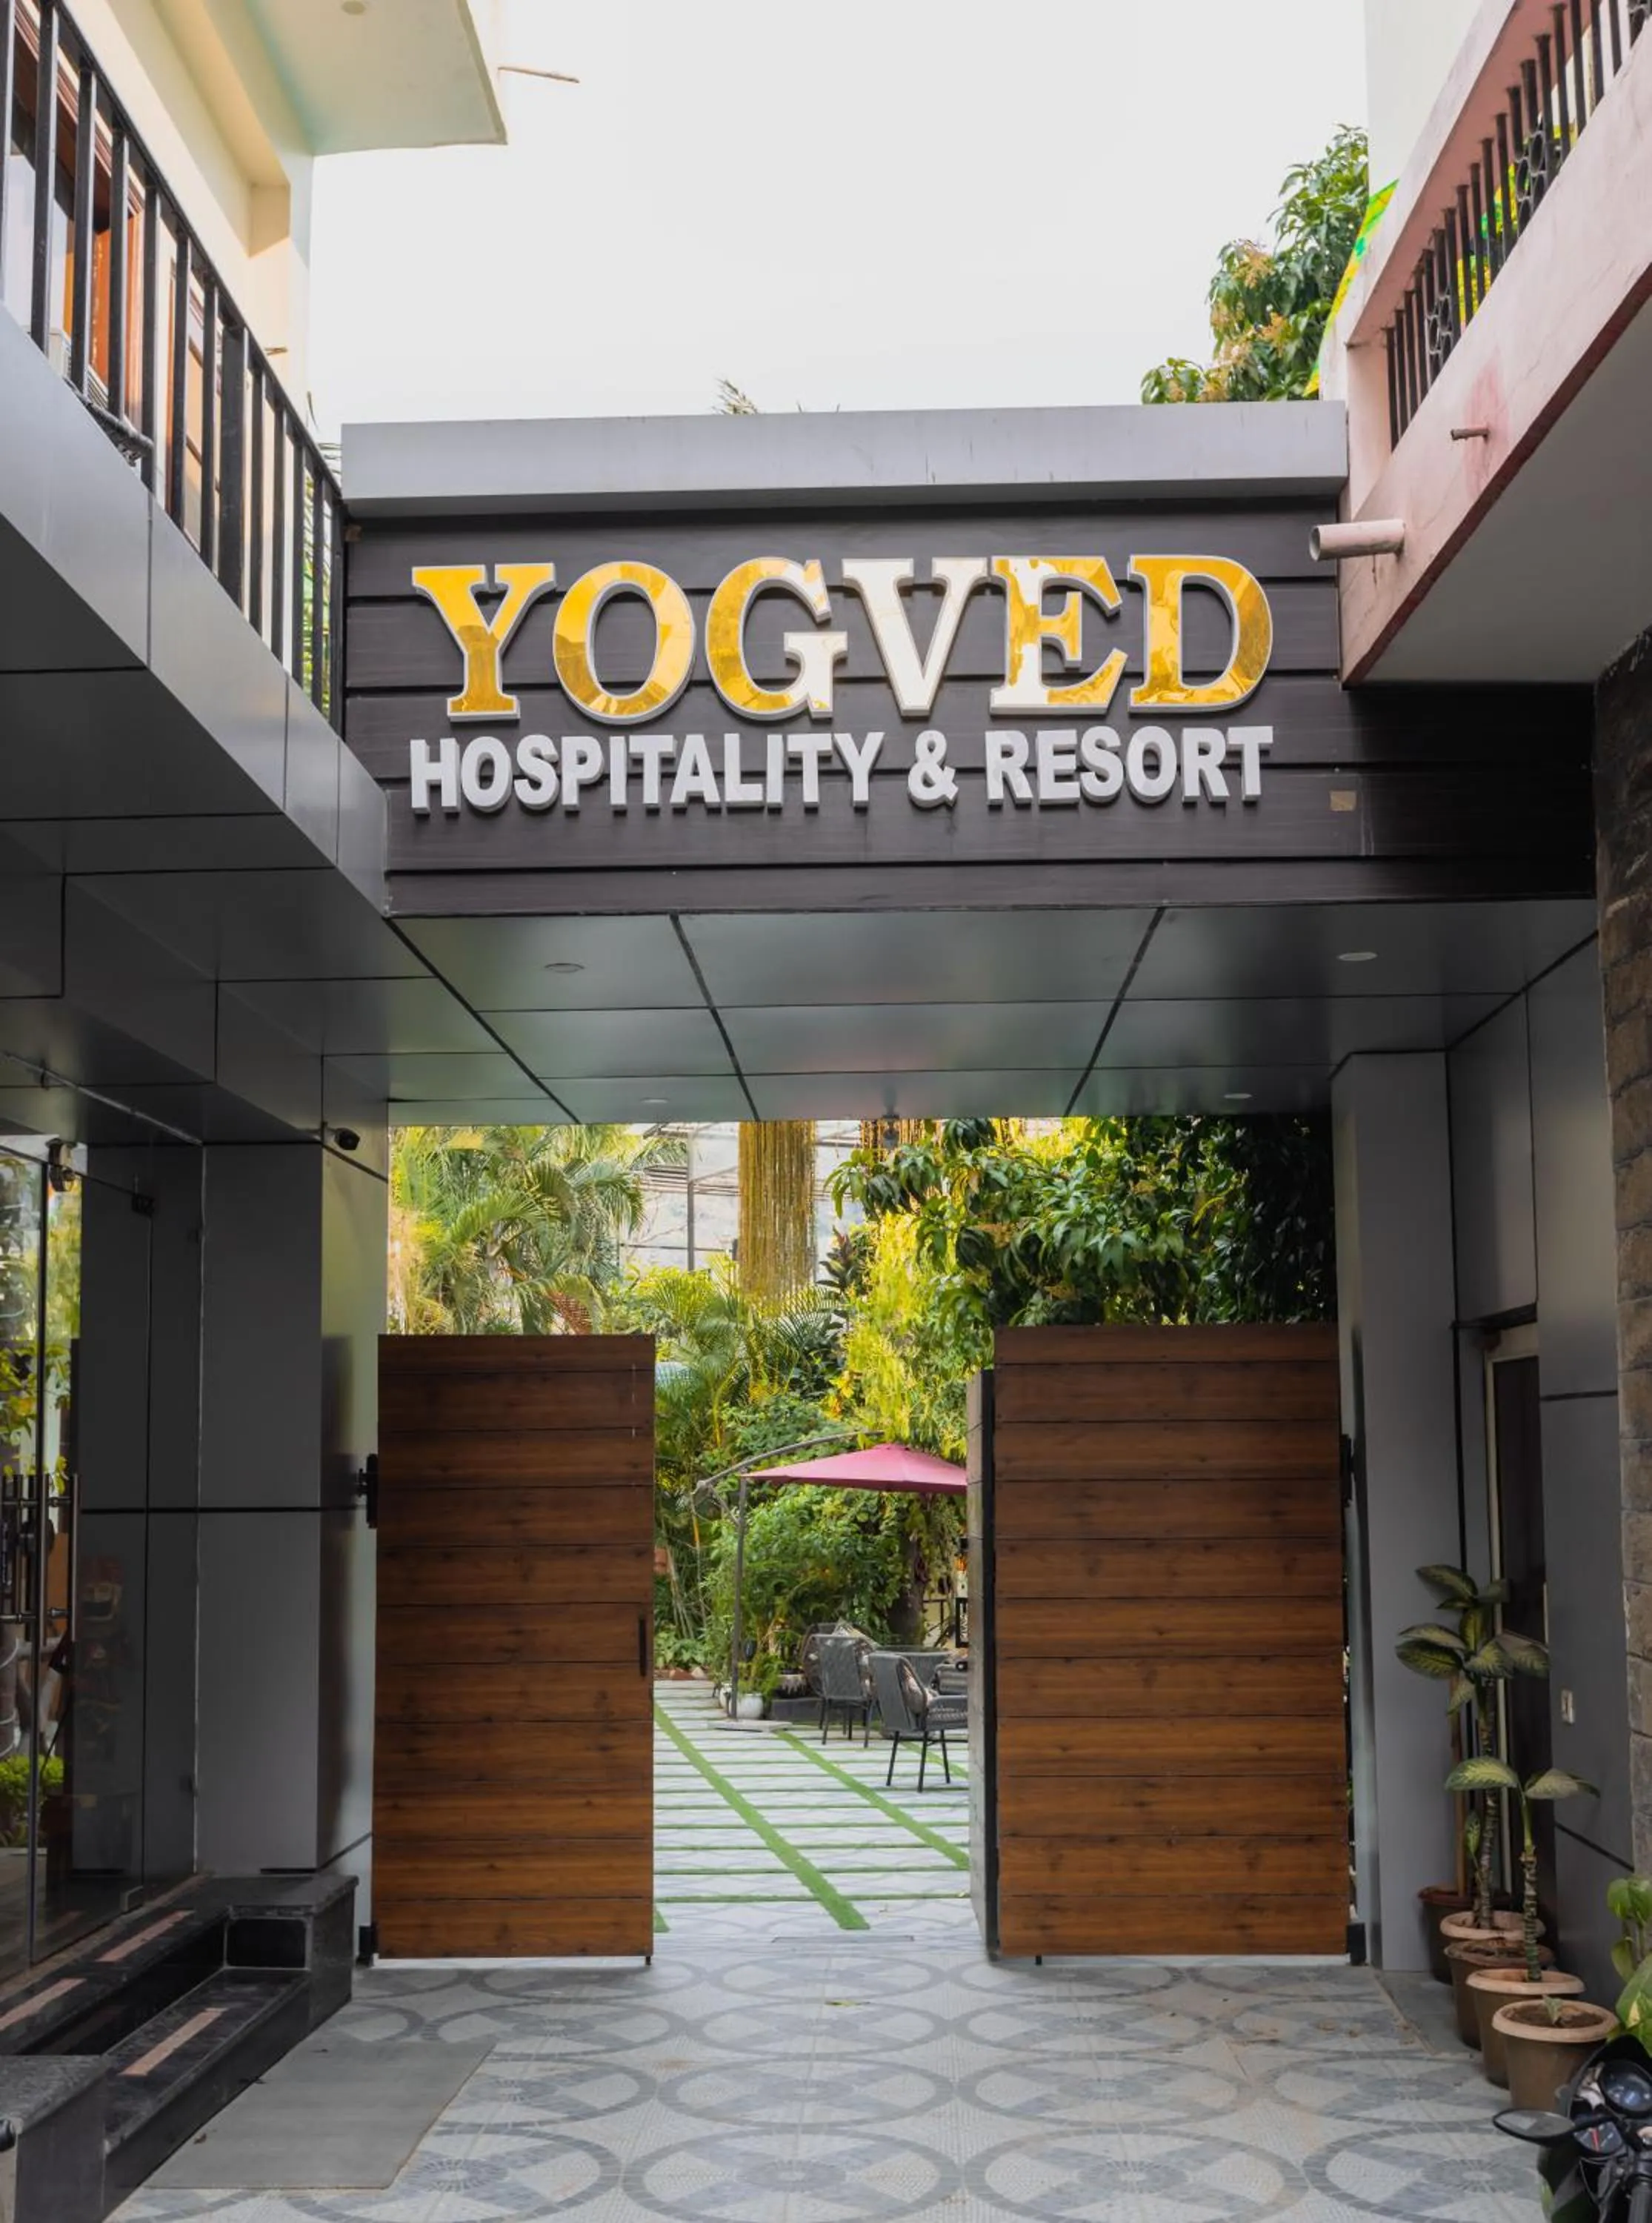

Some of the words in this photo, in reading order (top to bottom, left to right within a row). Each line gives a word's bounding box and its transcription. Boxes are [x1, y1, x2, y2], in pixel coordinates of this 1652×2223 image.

[411, 555, 1273, 725] YOGVED
[410, 731, 885, 814] HOSPITALITY
[906, 730, 959, 808] &
[984, 725, 1273, 805] RESORT
